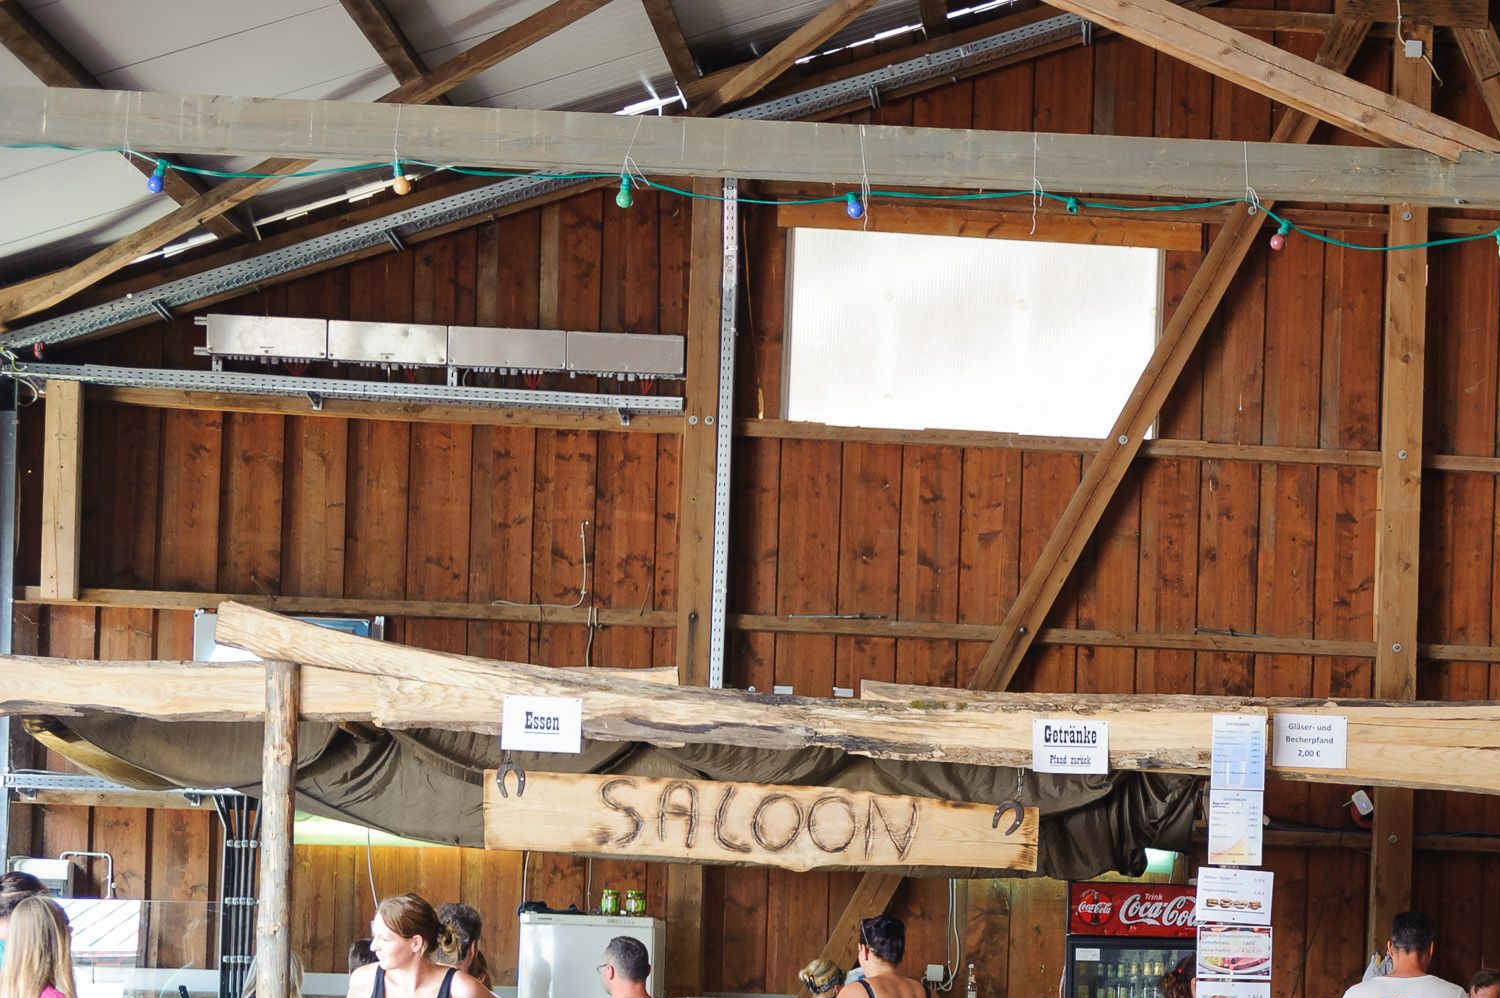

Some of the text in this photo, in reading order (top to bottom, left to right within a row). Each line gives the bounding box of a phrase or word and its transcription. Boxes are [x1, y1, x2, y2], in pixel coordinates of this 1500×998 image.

[525, 711, 560, 731] Essen
[1288, 722, 1332, 732] Gläser- und
[1044, 725, 1097, 744] Getränke
[1285, 735, 1334, 746] Becherpfand
[1049, 754, 1092, 765] Pfand zurück
[1297, 749, 1315, 759] 2,00
[599, 778, 920, 862] SALOON
[1145, 892, 1164, 900] Trink
[1119, 893, 1207, 927] Coca-Col
